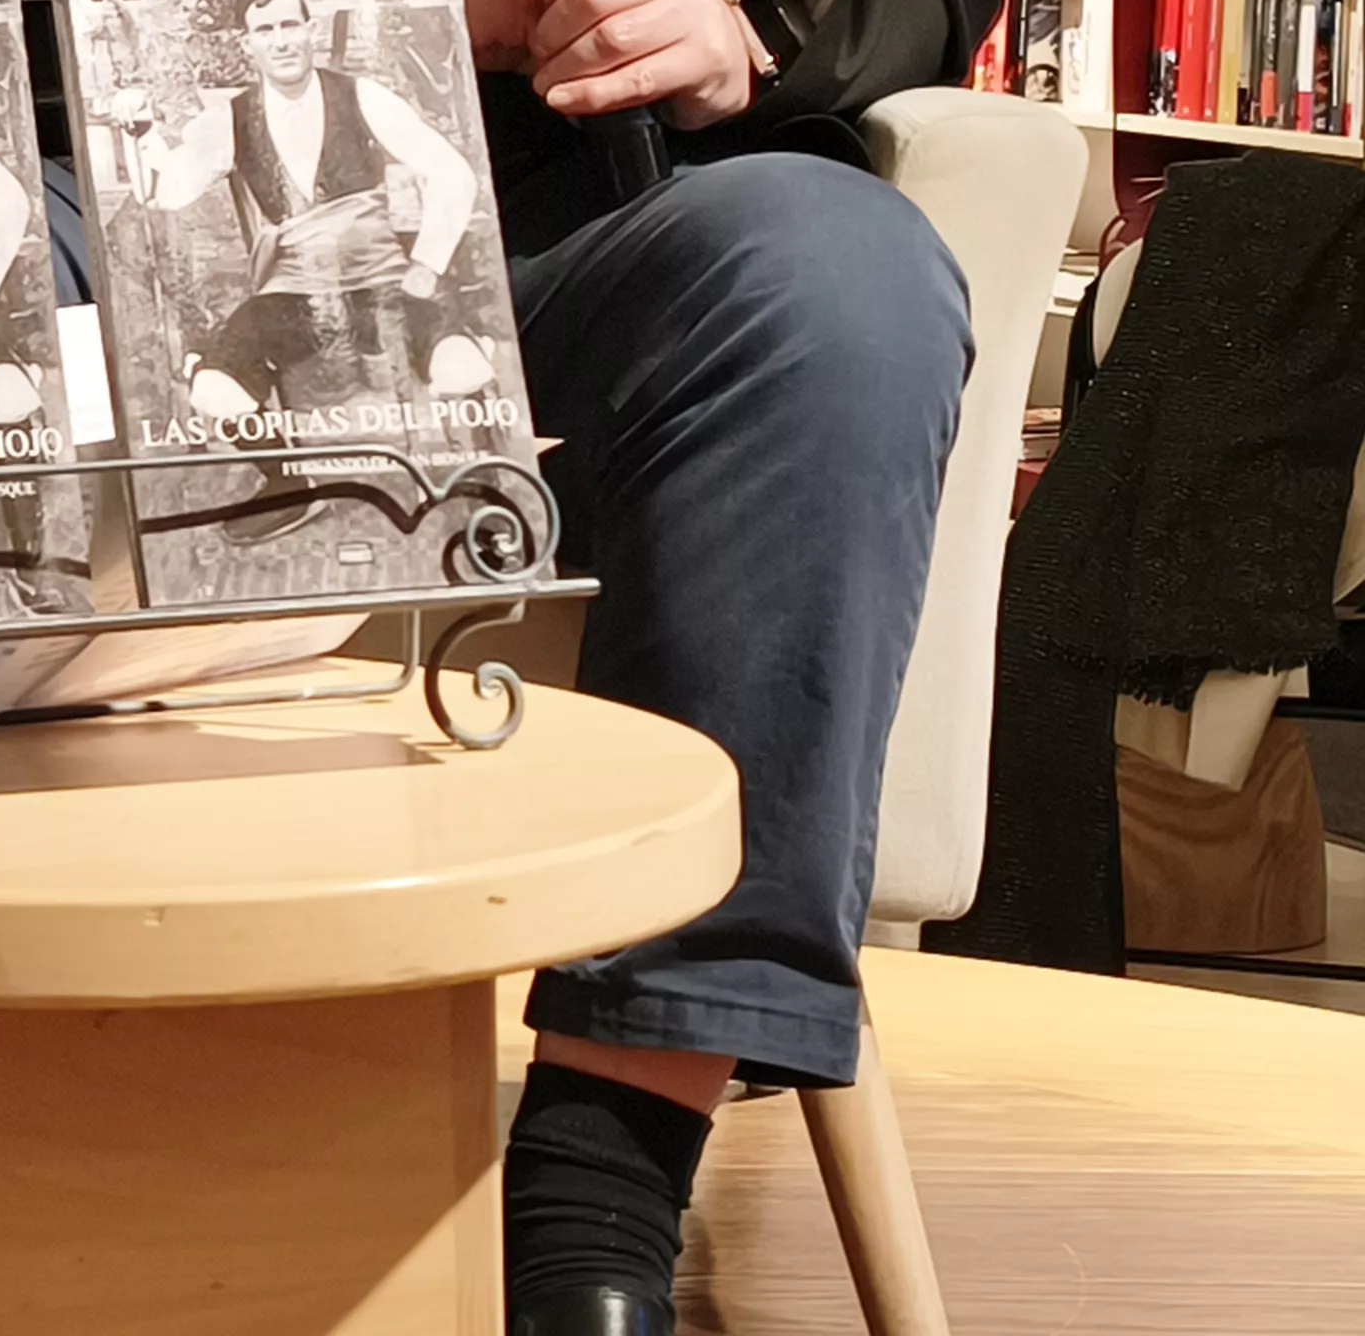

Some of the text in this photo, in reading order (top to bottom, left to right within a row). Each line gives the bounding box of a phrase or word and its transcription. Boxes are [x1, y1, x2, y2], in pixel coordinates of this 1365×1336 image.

[141, 397, 519, 448] LAS COPLAS DEL PIOJO
